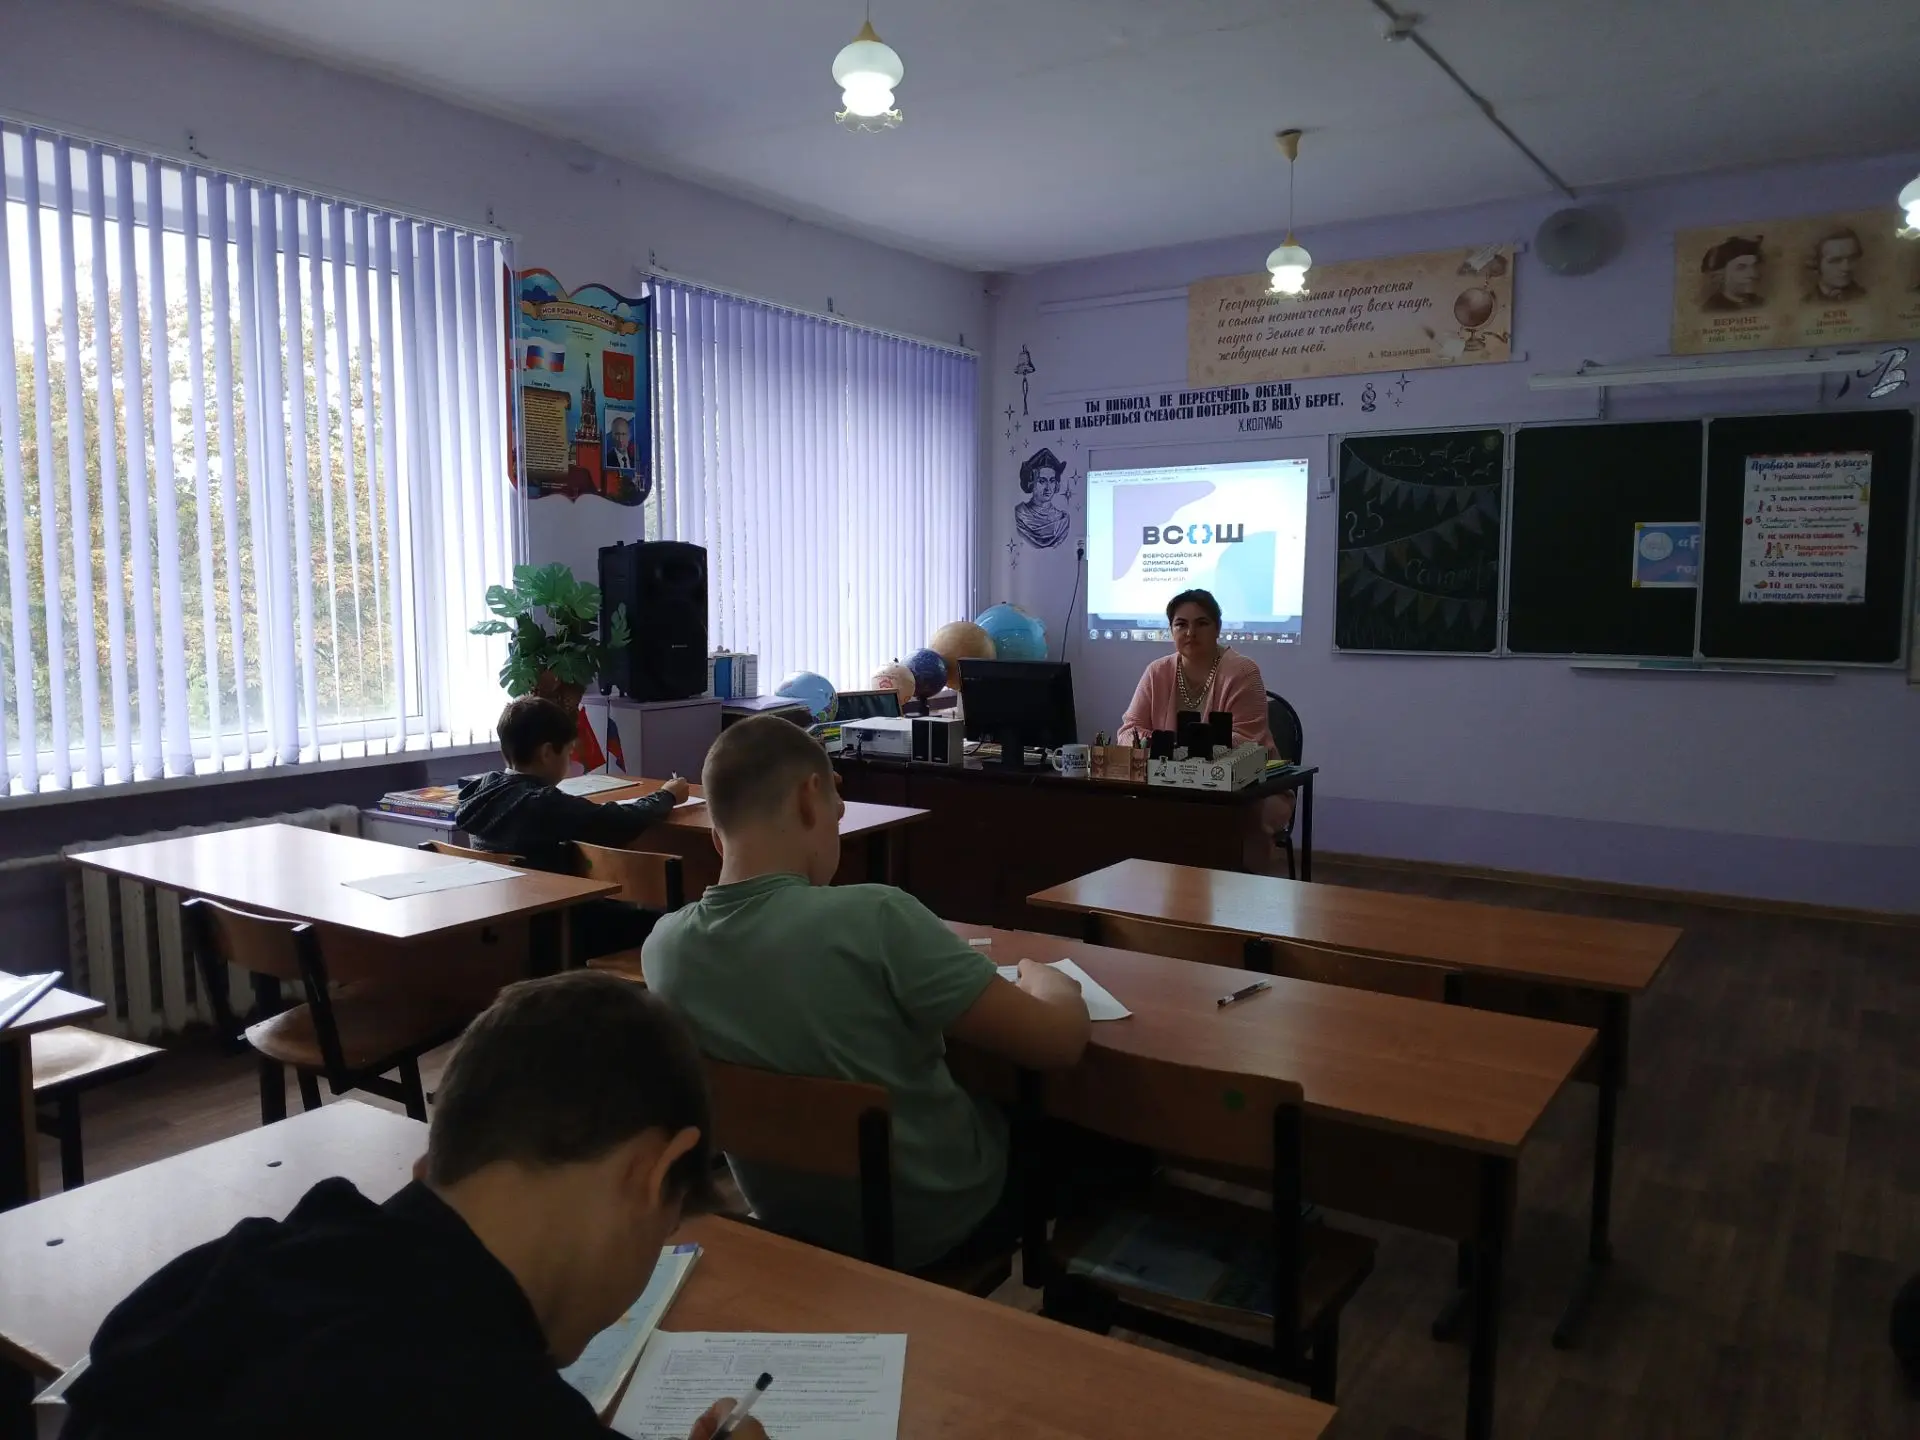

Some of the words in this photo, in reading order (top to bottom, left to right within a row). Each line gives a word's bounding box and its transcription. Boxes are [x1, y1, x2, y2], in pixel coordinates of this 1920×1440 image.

[1219, 297, 1279, 313] География
[1339, 281, 1414, 302] героическая
[1218, 319, 1225, 328] и
[1229, 315, 1265, 328] самая
[1268, 307, 1346, 324] поэтическая
[1350, 305, 1364, 319] из
[1368, 298, 1394, 313] всех
[1397, 297, 1432, 313] наук,
[1218, 334, 1253, 348] наука
[1256, 333, 1263, 342] о
[1266, 326, 1304, 341] Земле
[1308, 327, 1316, 336] и
[1320, 318, 1375, 335] человеке,
[1218, 346, 1278, 364] живущем
[1282, 345, 1298, 356] на
[1301, 341, 1326, 354] ней.
[1033, 420, 1055, 432] ЕСЛИ
[1059, 418, 1071, 430] НЕ
[1074, 410, 1140, 429] НАБЕРЁШЬСЯ
[1144, 407, 1194, 423] СМЕЛОСТИ
[1197, 401, 1250, 417] ПОТЕРЯТЬ
[1253, 399, 1267, 412] ИЗ
[1272, 397, 1301, 411] ВИДУ
[1305, 393, 1343, 408] БЕРЕГ.
[1085, 400, 1100, 413] ТЫ
[1105, 396, 1151, 411] НИКОГДА
[1160, 394, 1173, 407] НЕ
[1179, 387, 1250, 406] ПЕРЕСЕЧЁШЬ
[1142, 552, 1203, 560] ВСЕРОССИЙСКАЯ
